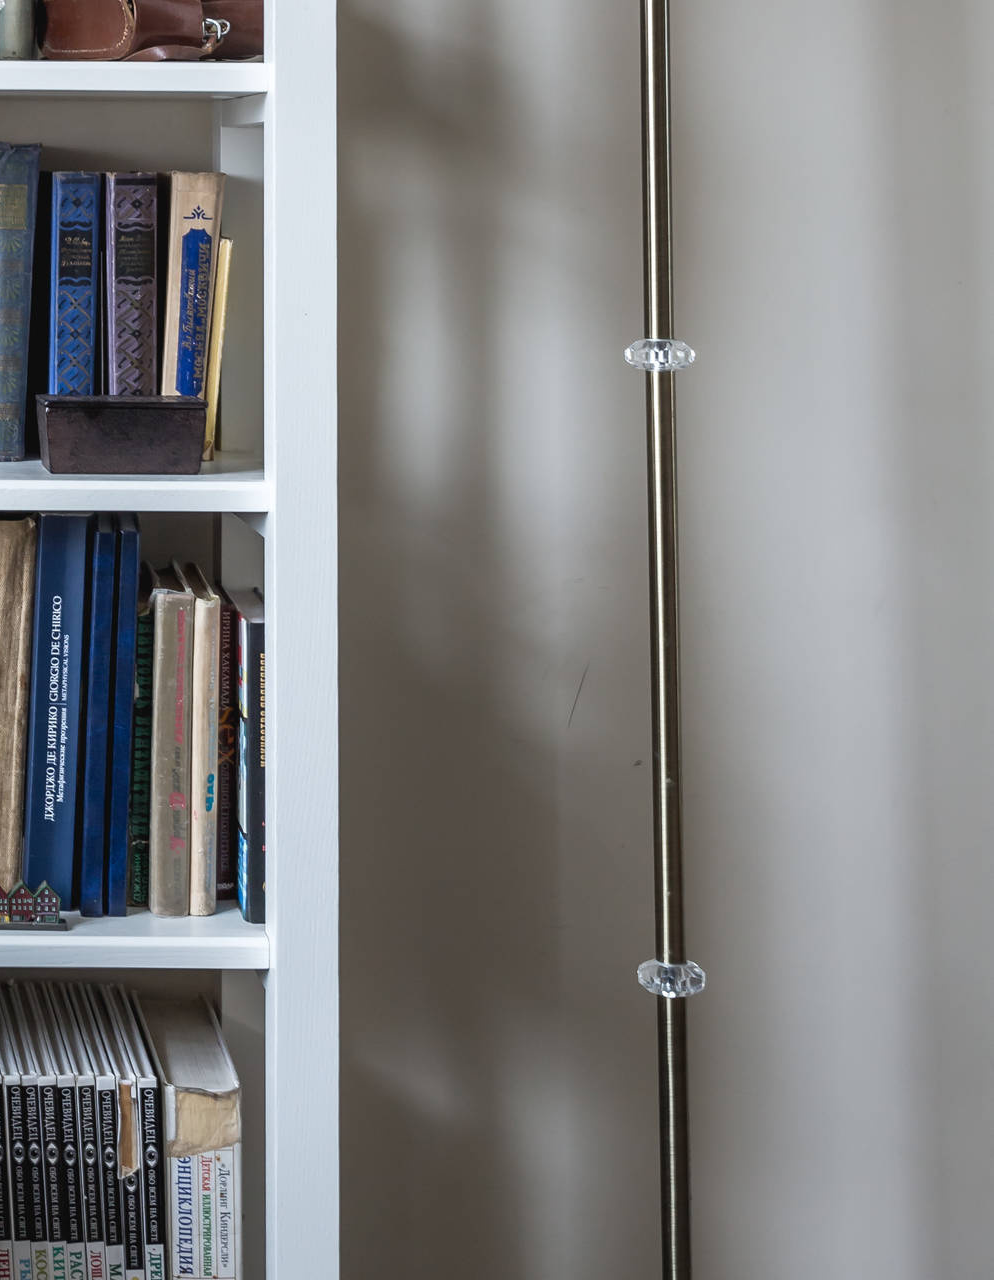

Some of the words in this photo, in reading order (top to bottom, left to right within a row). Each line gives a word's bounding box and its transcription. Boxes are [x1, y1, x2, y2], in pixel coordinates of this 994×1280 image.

[52, 595, 62, 640] CHIRICO
[222, 612, 231, 650] ИРИНА
[50, 641, 60, 656] DE
[62, 634, 70, 657] VISIONS
[49, 658, 60, 702] GIORGIO
[222, 652, 231, 711] ХАКАМАДА
[47, 706, 58, 749] КИРИКО
[46, 751, 56, 766] ДЕ
[44, 767, 56, 822] ДЖОРДЖО
[11, 1086, 23, 1140] ОЧЕВИДЕЦ
[26, 1086, 39, 1141] ОЧЕВИДЕЦ
[43, 1086, 56, 1141] ОЧЕВИДЕЦ
[61, 1088, 74, 1143] ОЧЕВИДЕЦ
[81, 1087, 94, 1142] ОЧЕВИДЕЦ
[101, 1090, 114, 1144] ОЧЕВИДЕЦ
[144, 1089, 156, 1144] ОЧЕВИДЕЦ
[175, 1156, 194, 1275] ЭНЦИКЛОПЕДИЯ
